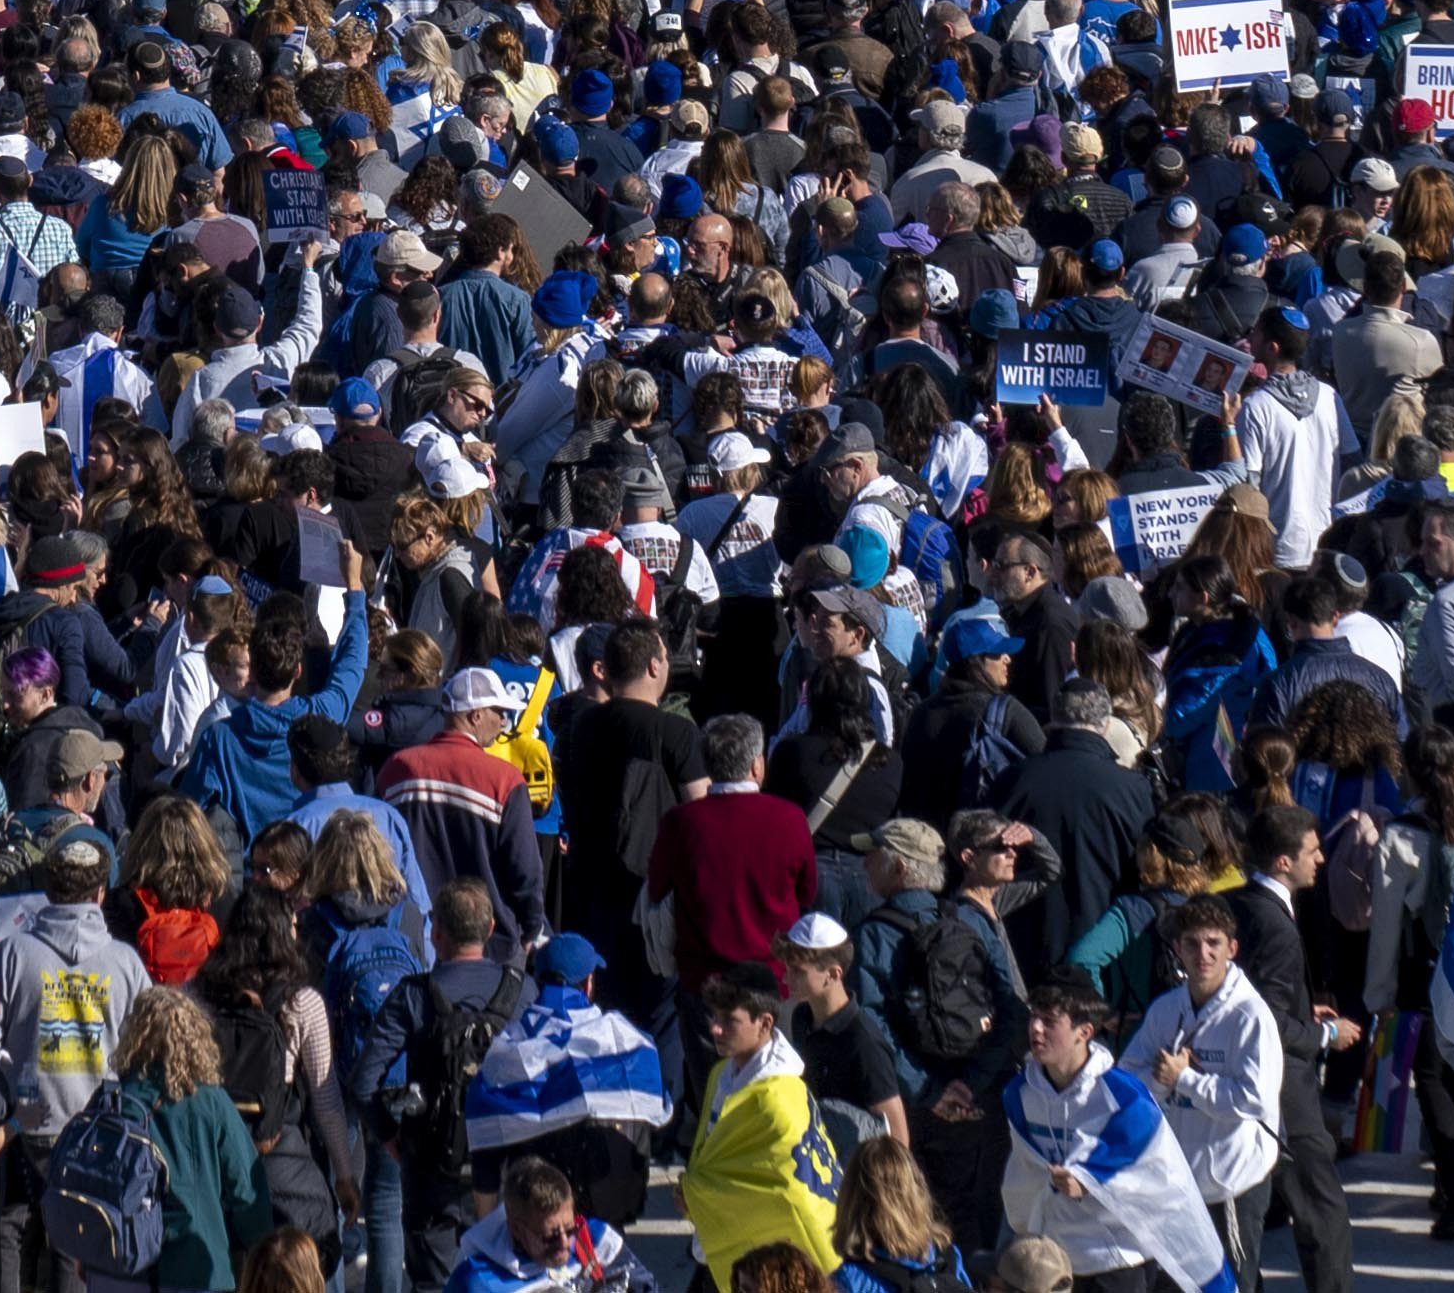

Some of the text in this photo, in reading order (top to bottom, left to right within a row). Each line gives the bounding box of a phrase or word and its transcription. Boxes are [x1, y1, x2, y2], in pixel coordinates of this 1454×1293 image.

[1177, 22, 1281, 57] MKE ISR
[286, 191, 317, 206] STAND
[273, 208, 304, 225] WITH
[1023, 342, 1086, 364] I STAND
[1001, 364, 1103, 389] WITH ISRAEL
[1135, 493, 1219, 515] NEW YORK
[1137, 512, 1199, 530] STANDS
[1140, 529, 1181, 546] WITH
